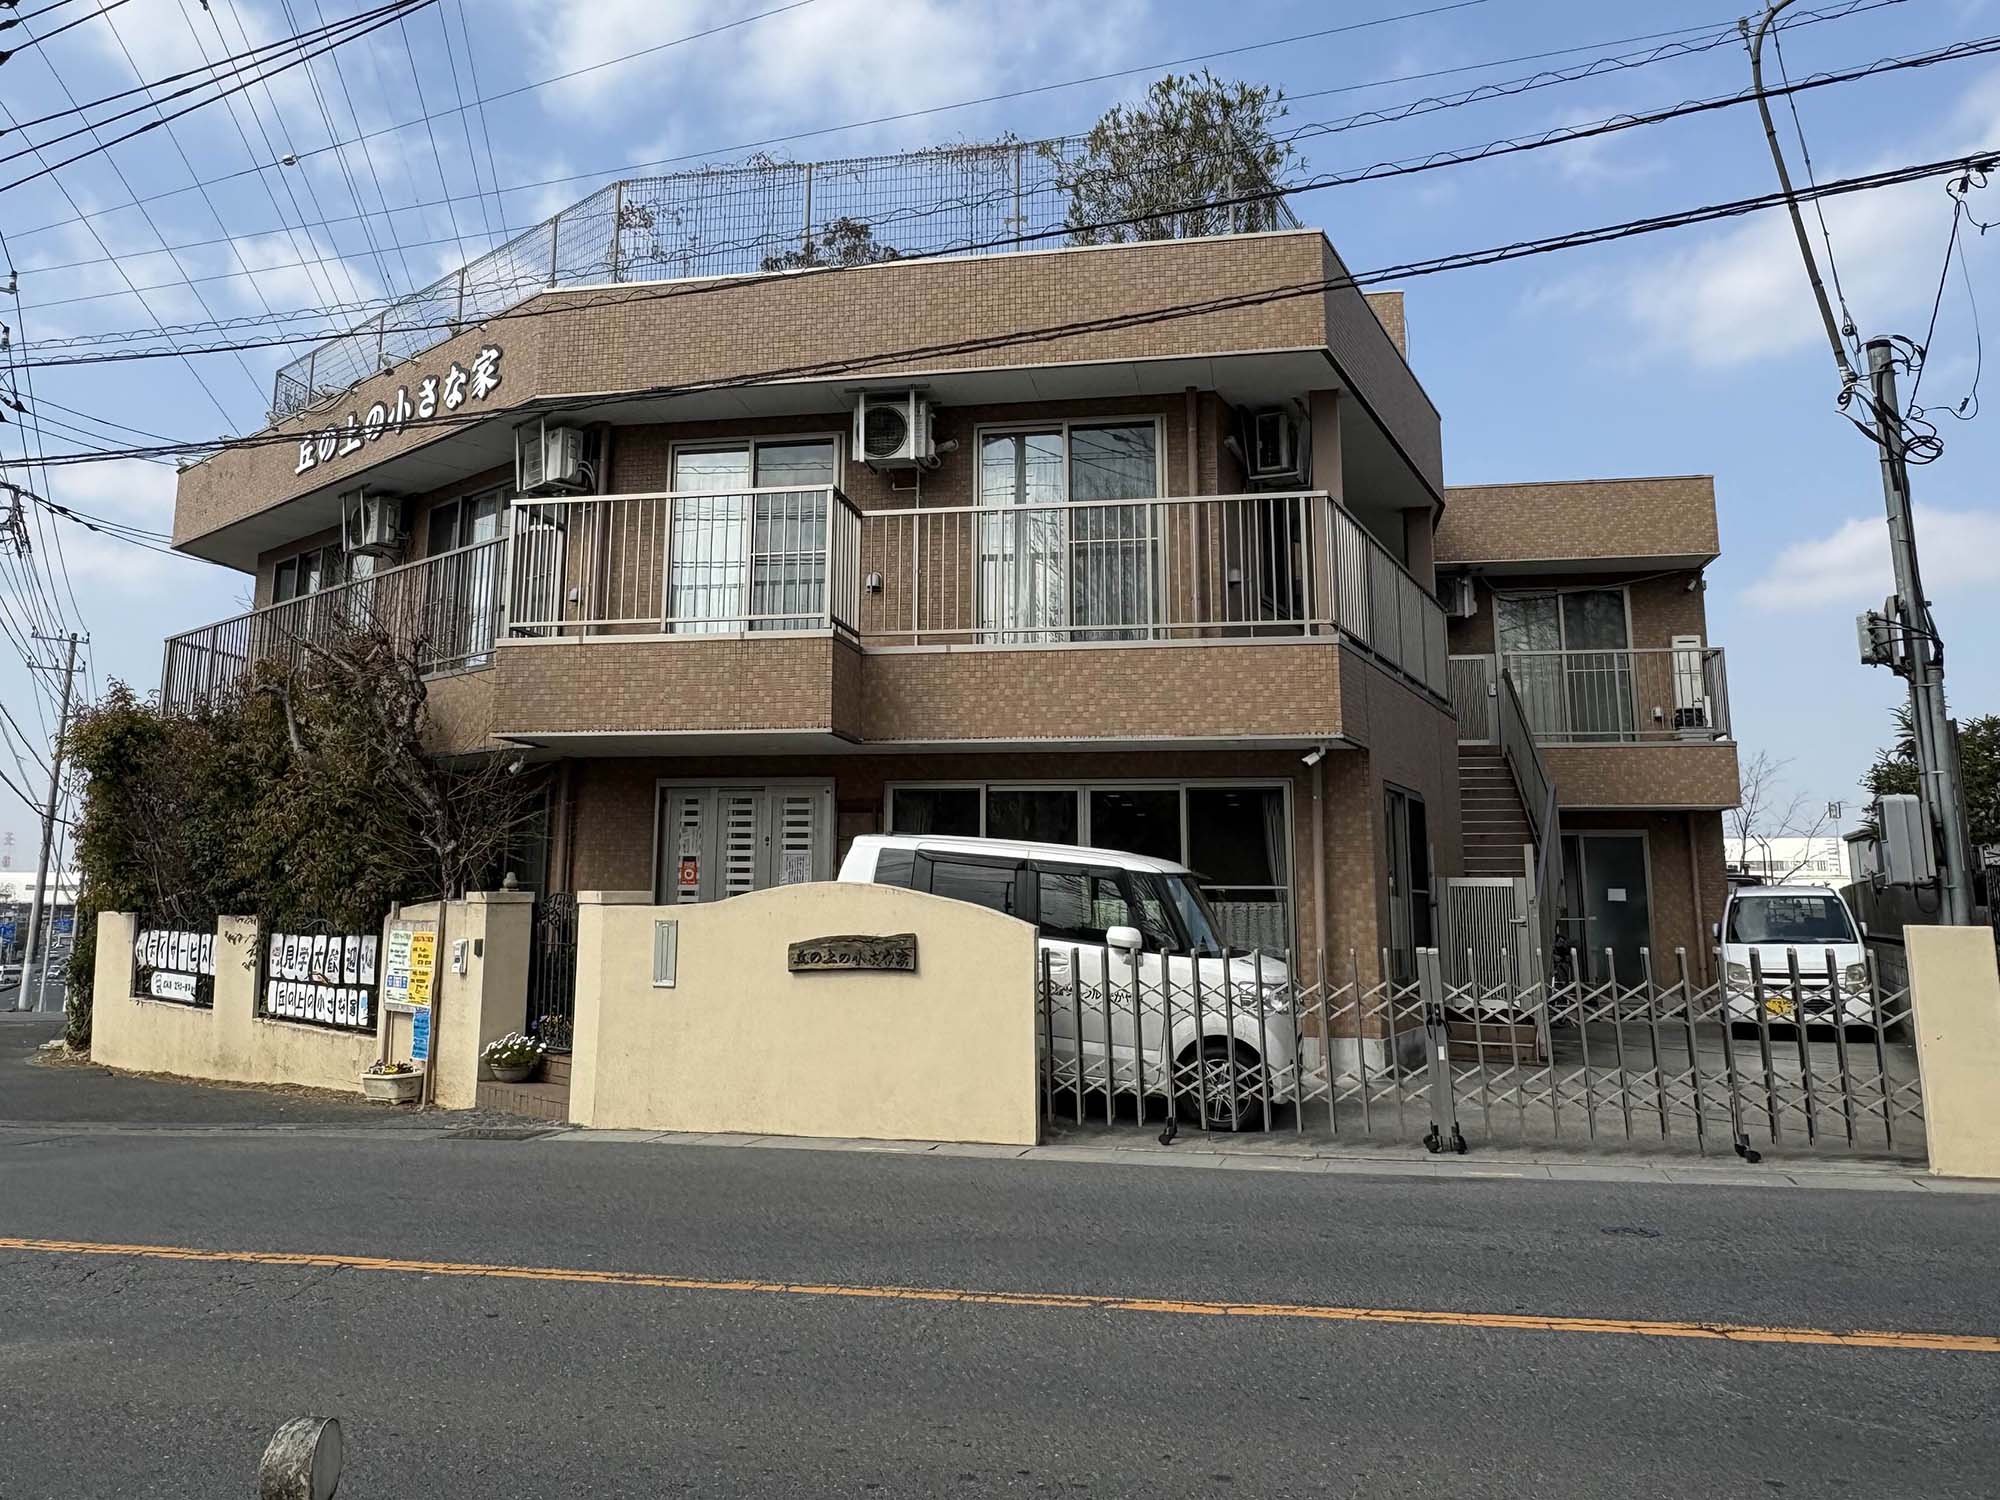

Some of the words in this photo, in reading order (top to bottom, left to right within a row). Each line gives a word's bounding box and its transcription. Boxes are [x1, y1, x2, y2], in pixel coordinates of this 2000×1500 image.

[295, 347, 500, 475] 丘の上の小さな家
